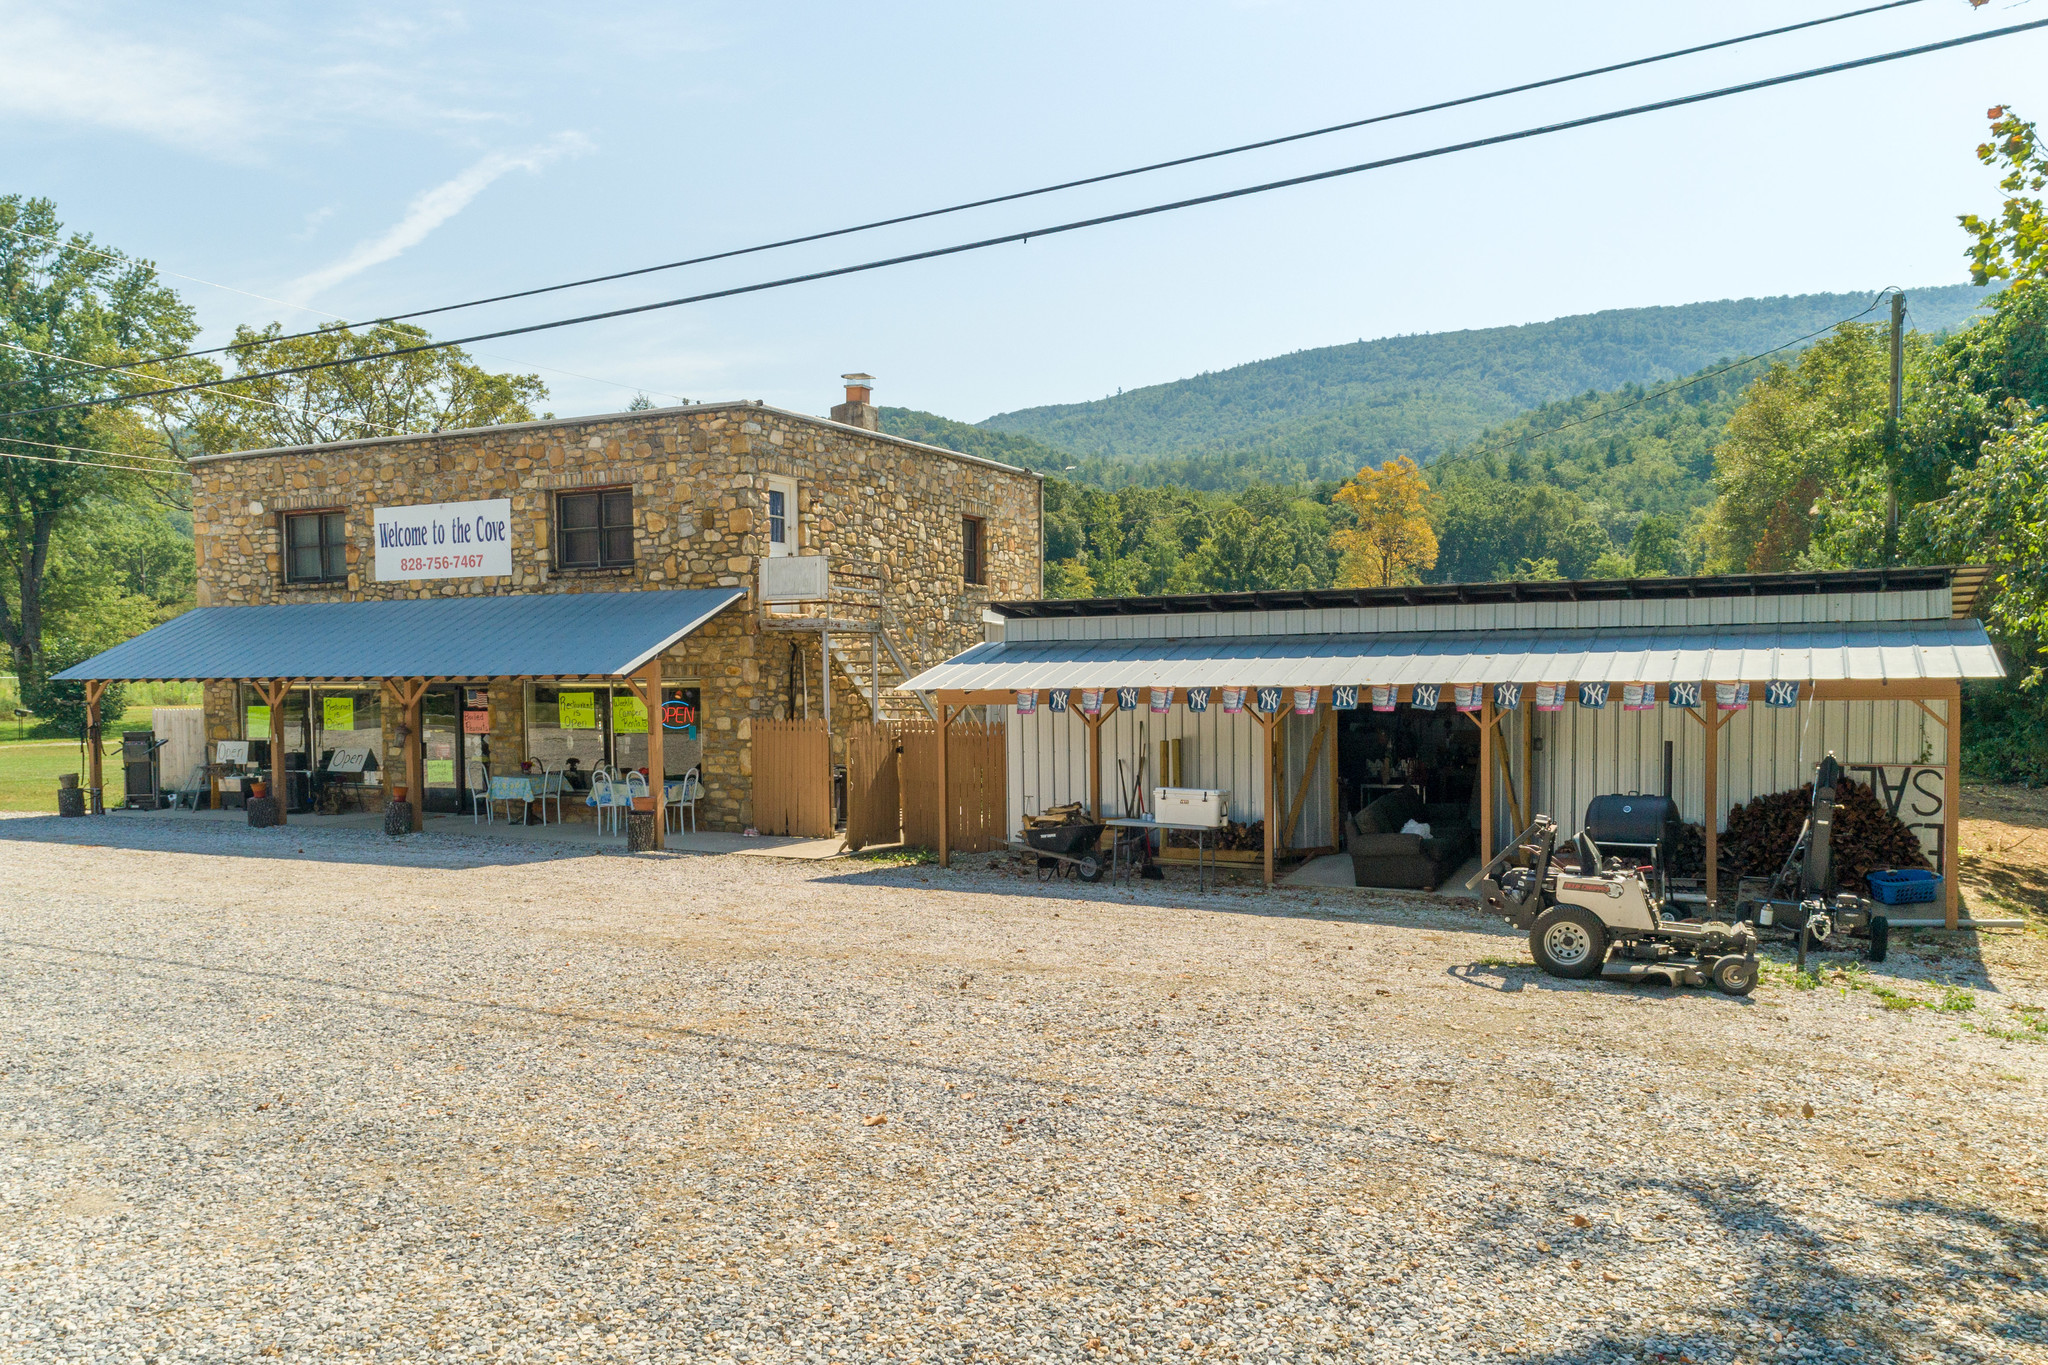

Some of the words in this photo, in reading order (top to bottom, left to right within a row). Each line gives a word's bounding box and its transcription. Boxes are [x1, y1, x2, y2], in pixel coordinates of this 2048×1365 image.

[379, 521, 427, 548] Welcome
[433, 520, 445, 544] to
[452, 517, 471, 544] the
[476, 516, 505, 542] Cove
[400, 554, 483, 571] 828-756-7467
[219, 743, 243, 761] Open
[332, 750, 363, 769] Open
